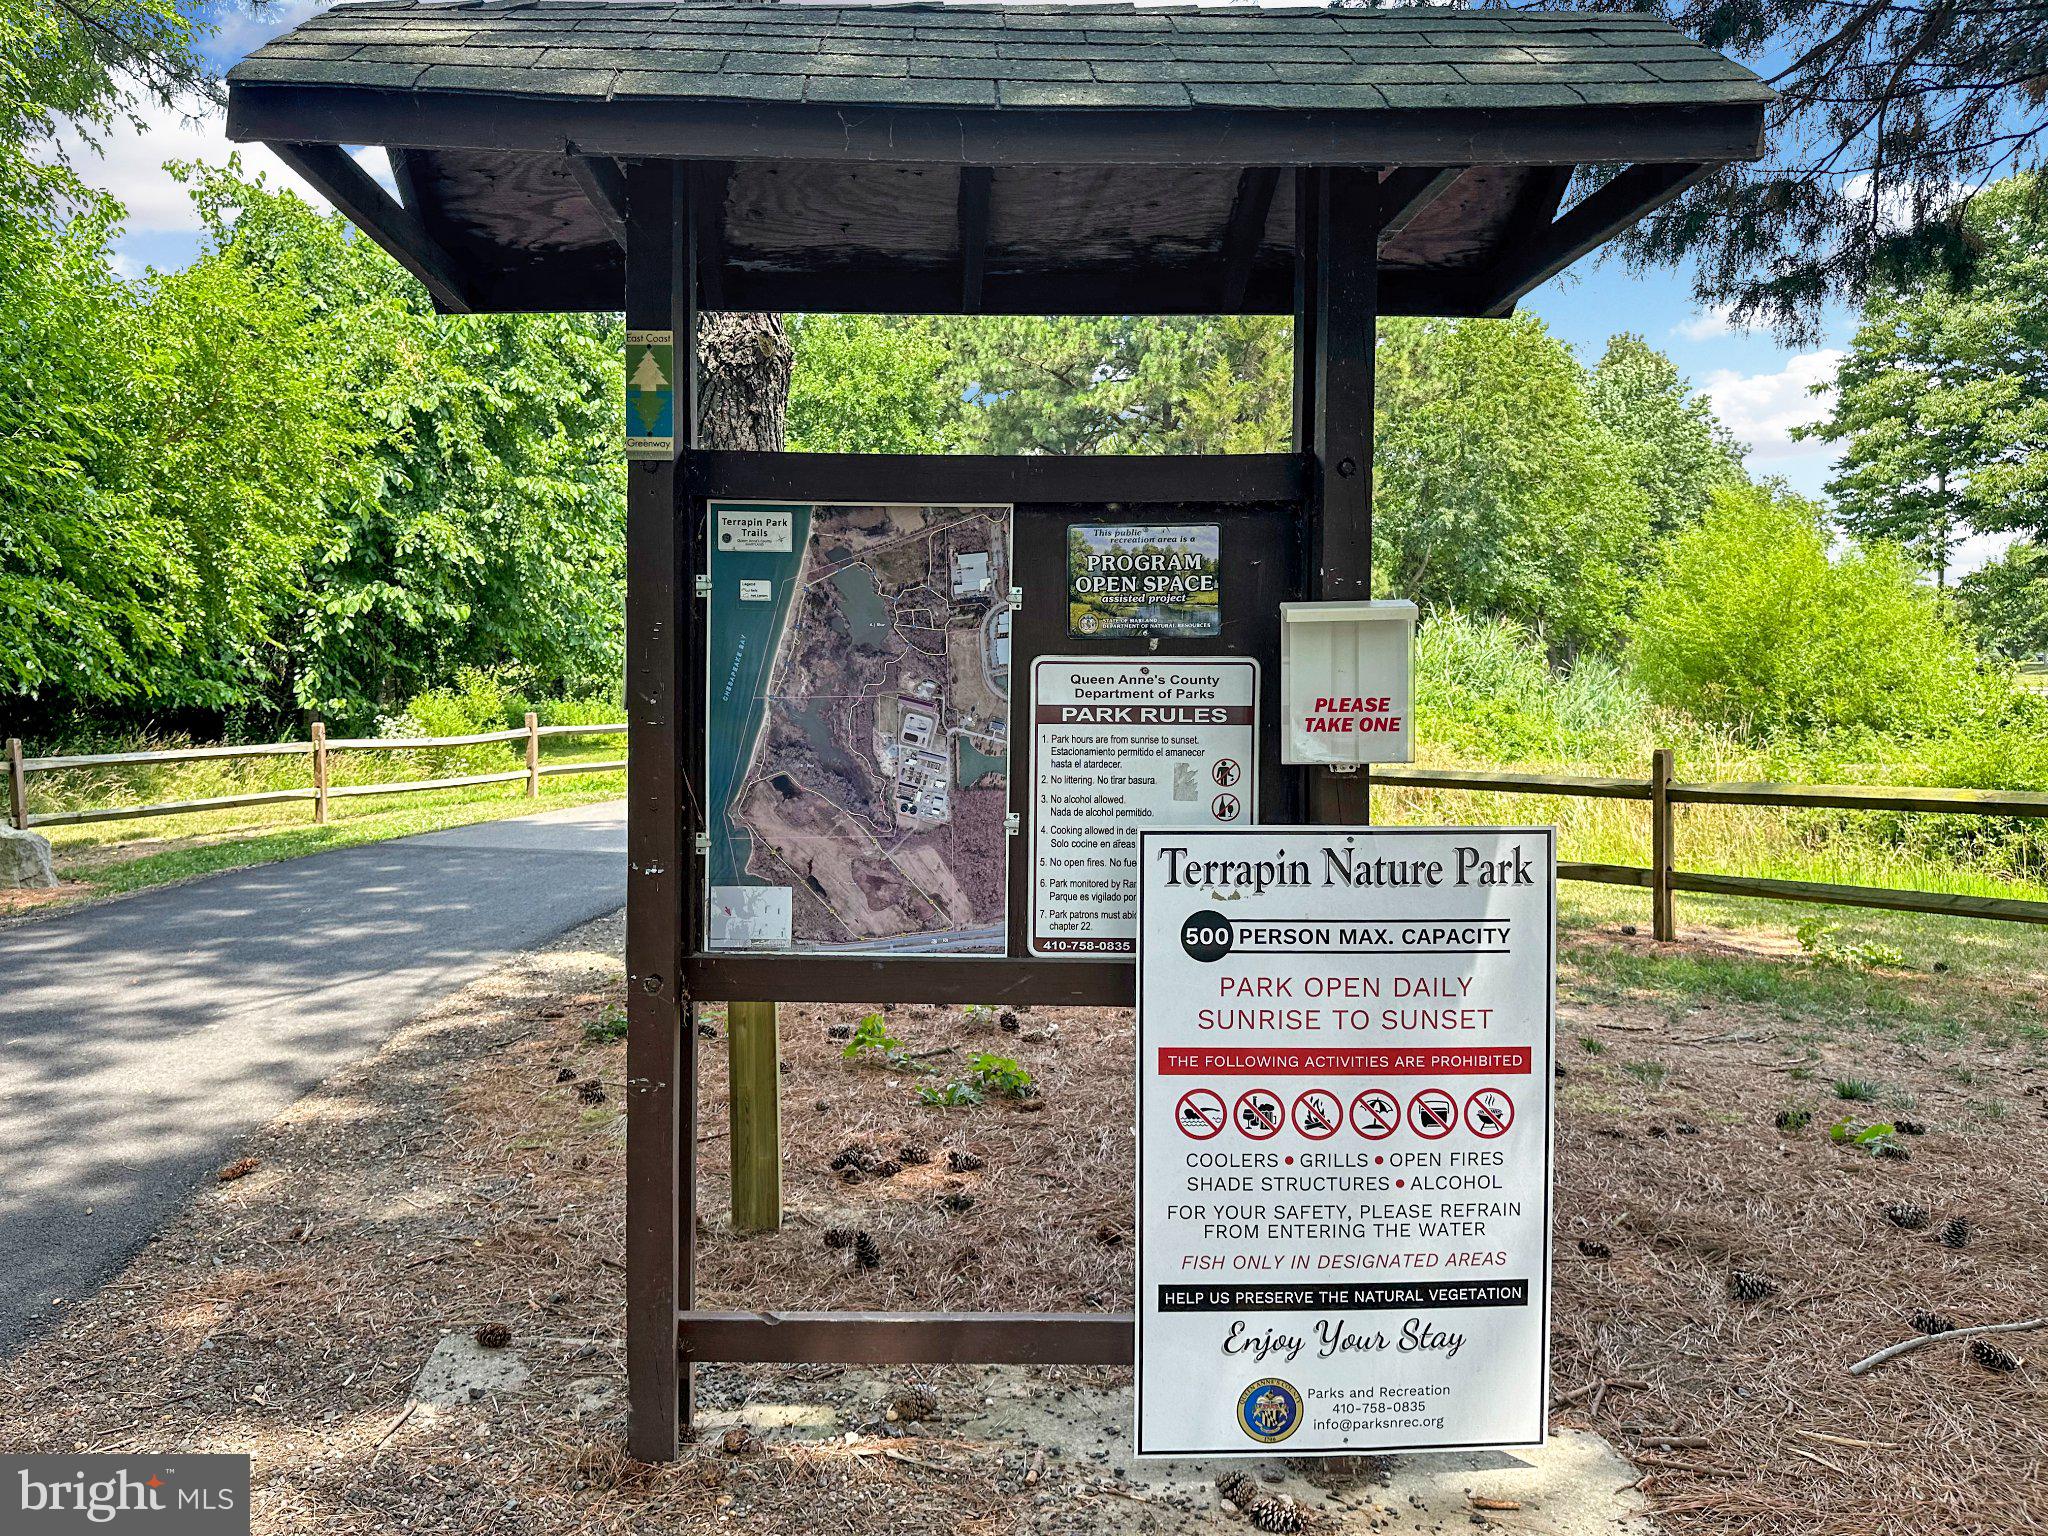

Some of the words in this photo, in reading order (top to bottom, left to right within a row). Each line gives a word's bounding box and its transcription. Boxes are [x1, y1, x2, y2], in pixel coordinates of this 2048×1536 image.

[627, 334, 643, 342] East
[646, 334, 671, 343] Coast
[627, 439, 670, 450] Greenway
[722, 518, 762, 529] Terrapin
[1115, 529, 1141, 537] public
[1087, 554, 1202, 571] PROGRAM
[1075, 576, 1137, 593] OPEN
[1144, 575, 1214, 592] SPACE
[1101, 594, 1145, 603] assisted
[1148, 594, 1186, 604] project
[1070, 674, 1114, 685] Queen
[1118, 675, 1165, 685] Anne's
[1170, 675, 1220, 687] County
[1075, 689, 1154, 700] Department
[1159, 689, 1172, 699] of
[1177, 690, 1215, 699] Parks
[1315, 698, 1390, 713] PLEASE
[1062, 708, 1132, 722] PARK
[1140, 708, 1228, 723] RULES
[1305, 718, 1353, 732] TAKE
[1359, 717, 1401, 732] ONE
[1052, 735, 1069, 743] Park
[1072, 735, 1094, 744] hours
[1110, 736, 1128, 744] from
[1162, 736, 1169, 744] to
[1171, 736, 1199, 744] sunset.
[1051, 748, 1115, 756] Estacionamiento
[1118, 748, 1153, 758] permitido
[1051, 760, 1072, 768] hasta
[1075, 760, 1081, 768] el
[1084, 760, 1122, 768] atardecer.
[1042, 775, 1048, 783] 2.
[1051, 775, 1062, 783] No
[1064, 776, 1094, 786] littering.
[1098, 776, 1108, 784] No
[1110, 776, 1126, 784] tirar
[1128, 776, 1157, 784] basura.
[1064, 795, 1091, 803] alcohol
[1094, 795, 1125, 804] allowed.
[1051, 808, 1071, 816] Nada
[1074, 808, 1083, 816] de
[1086, 808, 1113, 817] alcohol
[1116, 808, 1154, 818] permitido.
[1041, 826, 1048, 834] 4.
[1051, 826, 1082, 836] Cooking
[1085, 826, 1114, 834] allowed
[1117, 826, 1123, 834] in
[1051, 839, 1068, 847] Solo
[1072, 840, 1097, 848] cocine
[1040, 858, 1047, 866] 5.
[1050, 858, 1061, 866] No
[1064, 860, 1084, 868] open
[1087, 858, 1106, 867] fires.
[1110, 858, 1121, 867] No
[1158, 848, 1312, 896] Terrapin
[1320, 847, 1444, 887] Nature
[1452, 845, 1534, 887] Park
[1040, 879, 1047, 887] 6.
[1050, 879, 1067, 887] Park
[1070, 879, 1108, 887] monitored
[1111, 879, 1120, 890] by
[1050, 892, 1077, 902] Parque
[1091, 893, 1121, 903] vigilado
[1124, 895, 1136, 903] por
[1040, 910, 1046, 918] 7.
[1050, 910, 1067, 918] Park
[1070, 911, 1098, 920] patrons
[1101, 911, 1120, 919] must
[1050, 922, 1078, 931] chapter
[1081, 922, 1092, 930] 22.
[1185, 927, 1228, 945] 500
[1239, 928, 1330, 944] PERSON
[1339, 929, 1394, 944] MAX.
[1402, 928, 1511, 944] CAPACITY
[1043, 941, 1130, 950] 410-758-0835
[1220, 977, 1292, 997] PARK
[1305, 977, 1380, 998] OPEN
[1394, 977, 1474, 997] DAILY
[1198, 1010, 1321, 1030] SUNRISE
[1332, 1009, 1369, 1030] TO
[1381, 1009, 1494, 1030] SUNSET
[1168, 1055, 1199, 1068] THE
[1205, 1055, 1300, 1068] FOLLOWING
[1305, 1055, 1389, 1068] ACTIVITIES
[1394, 1054, 1426, 1068] ARE
[1431, 1054, 1523, 1068] PROHIBITED
[1186, 1153, 1279, 1168] COOLERS
[1300, 1153, 1368, 1168] GRILLS
[1389, 1153, 1441, 1167] OPEN
[1450, 1151, 1503, 1166] FIRES
[1187, 1177, 1253, 1192] SHADE
[1261, 1176, 1389, 1191] STRUCTURES
[1411, 1175, 1503, 1191] ALCOHOL
[1167, 1206, 1206, 1220] FOR
[1213, 1205, 1266, 1220] YOUR
[1274, 1204, 1352, 1221] SAFETY,
[1360, 1204, 1433, 1219] PLEASE
[1441, 1202, 1521, 1218] REFRAIN
[1204, 1224, 1259, 1239] FROM
[1268, 1224, 1365, 1239] ENTERING
[1373, 1223, 1411, 1238] THE
[1418, 1221, 1485, 1237] WATER
[1182, 1255, 1225, 1270] FISH
[1233, 1254, 1284, 1270] ONLY
[1291, 1254, 1309, 1270] IN
[1318, 1253, 1438, 1269] DESIGNATED
[1446, 1252, 1507, 1268] AREAS
[1165, 1292, 1204, 1305] HELP
[1209, 1292, 1230, 1305] US
[1235, 1291, 1314, 1304] PRESERVE
[1319, 1290, 1349, 1303] THE
[1354, 1289, 1424, 1303] NATURAL
[1428, 1287, 1522, 1301] VEGETATION
[1221, 1320, 1305, 1363] Enjoy
[1312, 1318, 1391, 1358] Your
[1398, 1317, 1466, 1359] Stay
[1307, 1387, 1345, 1400] Parks
[1349, 1386, 1374, 1398] and
[1380, 1384, 1450, 1397] Recreation
[1332, 1402, 1426, 1414] 410-758-0835
[1313, 1415, 1444, 1431] info@parksnrec.org
